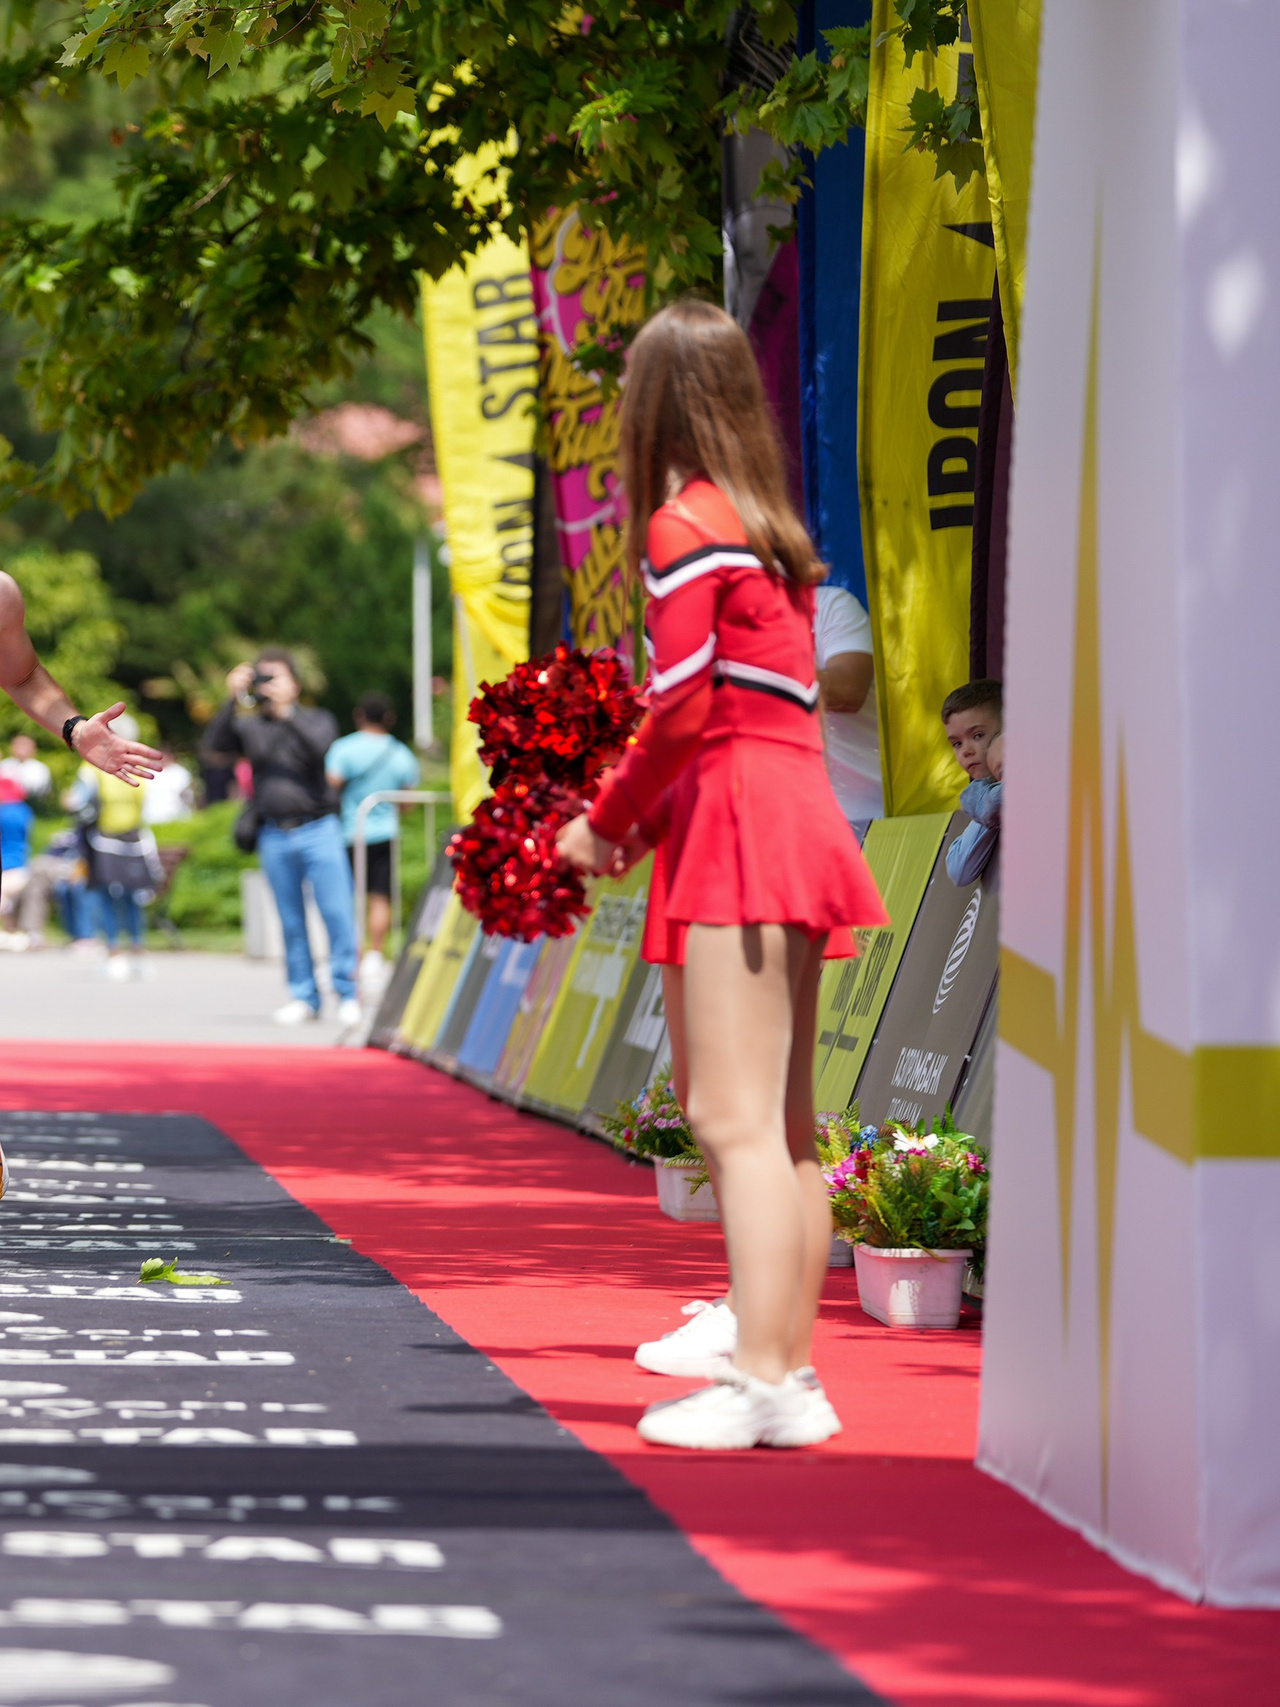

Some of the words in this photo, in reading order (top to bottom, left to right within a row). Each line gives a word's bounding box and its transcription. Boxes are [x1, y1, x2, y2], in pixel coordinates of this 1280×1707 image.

[472, 273, 538, 419] STAR
[851, 930, 896, 1018] STAR
[890, 1046, 949, 1096] ГАЗПРОМБАНК
[2, 1530, 446, 1567] STAR
[10, 1597, 502, 1634] STAR
